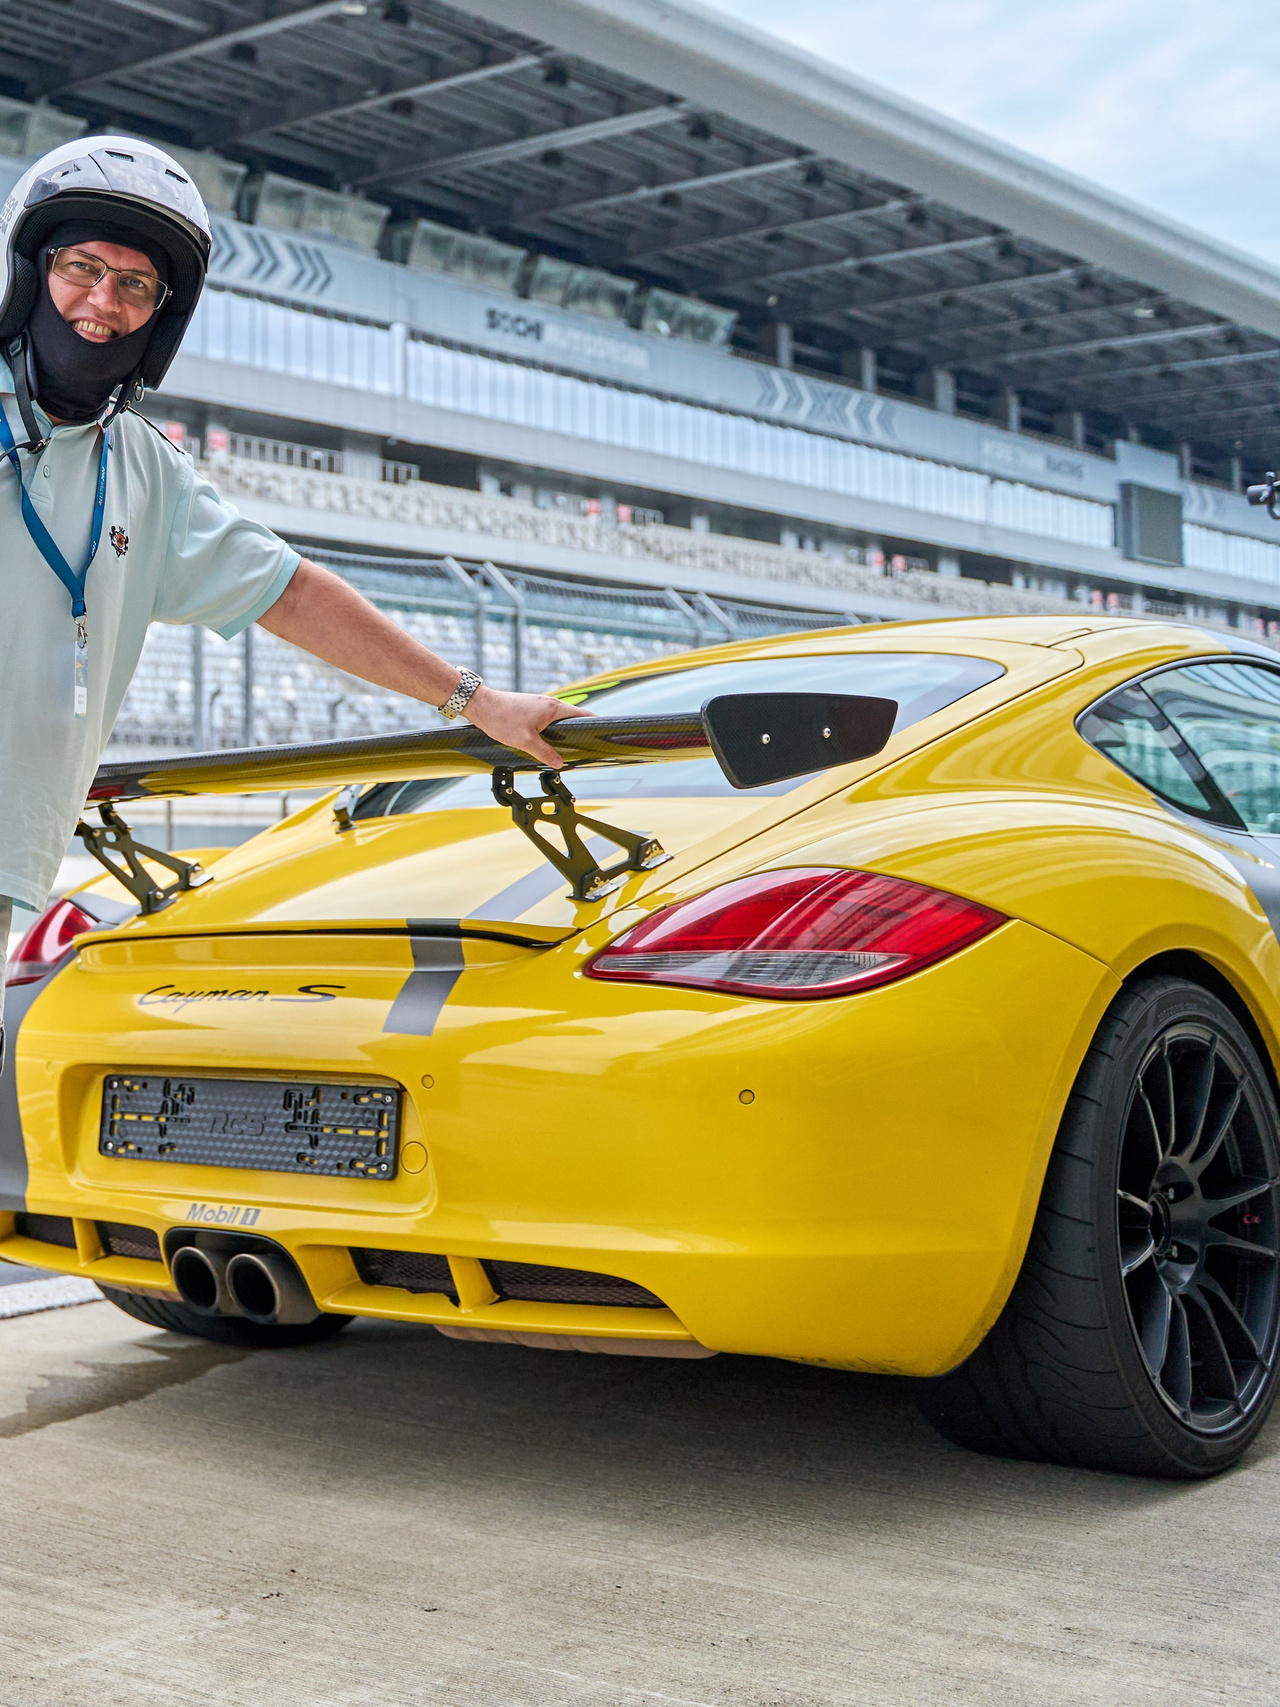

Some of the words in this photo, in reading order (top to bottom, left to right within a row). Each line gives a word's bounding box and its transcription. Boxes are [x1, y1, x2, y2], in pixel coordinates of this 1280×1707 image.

[137, 984, 269, 1014] Cayman
[269, 984, 347, 1003] S
[185, 1203, 240, 1225] Mobil
